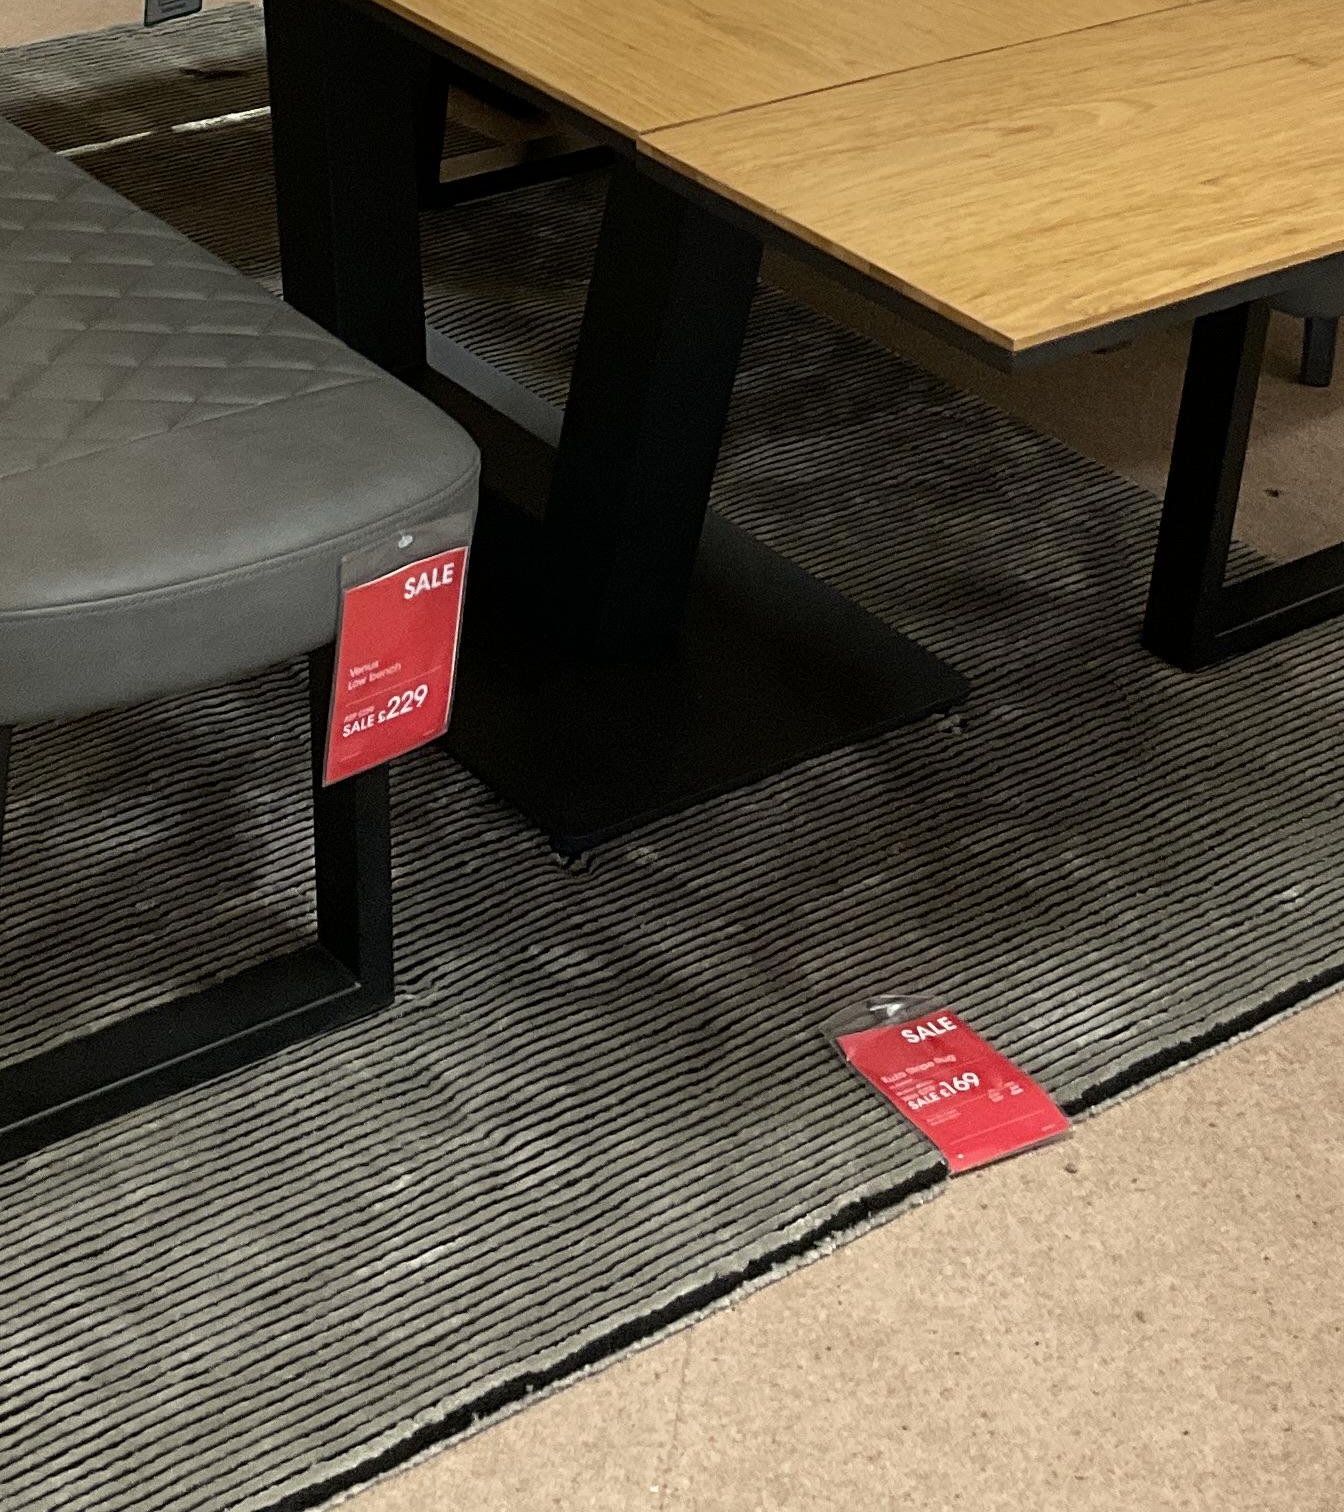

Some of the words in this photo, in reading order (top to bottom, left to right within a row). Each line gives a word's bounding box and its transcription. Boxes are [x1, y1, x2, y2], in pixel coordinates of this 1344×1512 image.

[403, 562, 455, 600] SALE
[348, 677, 367, 691] Low
[369, 662, 401, 682] bench
[350, 660, 379, 678] Venus
[343, 713, 375, 738] SALE
[377, 684, 428, 724] £229
[901, 1016, 957, 1044] SALE
[907, 1091, 941, 1110] SALE
[939, 1072, 980, 1099] £169
